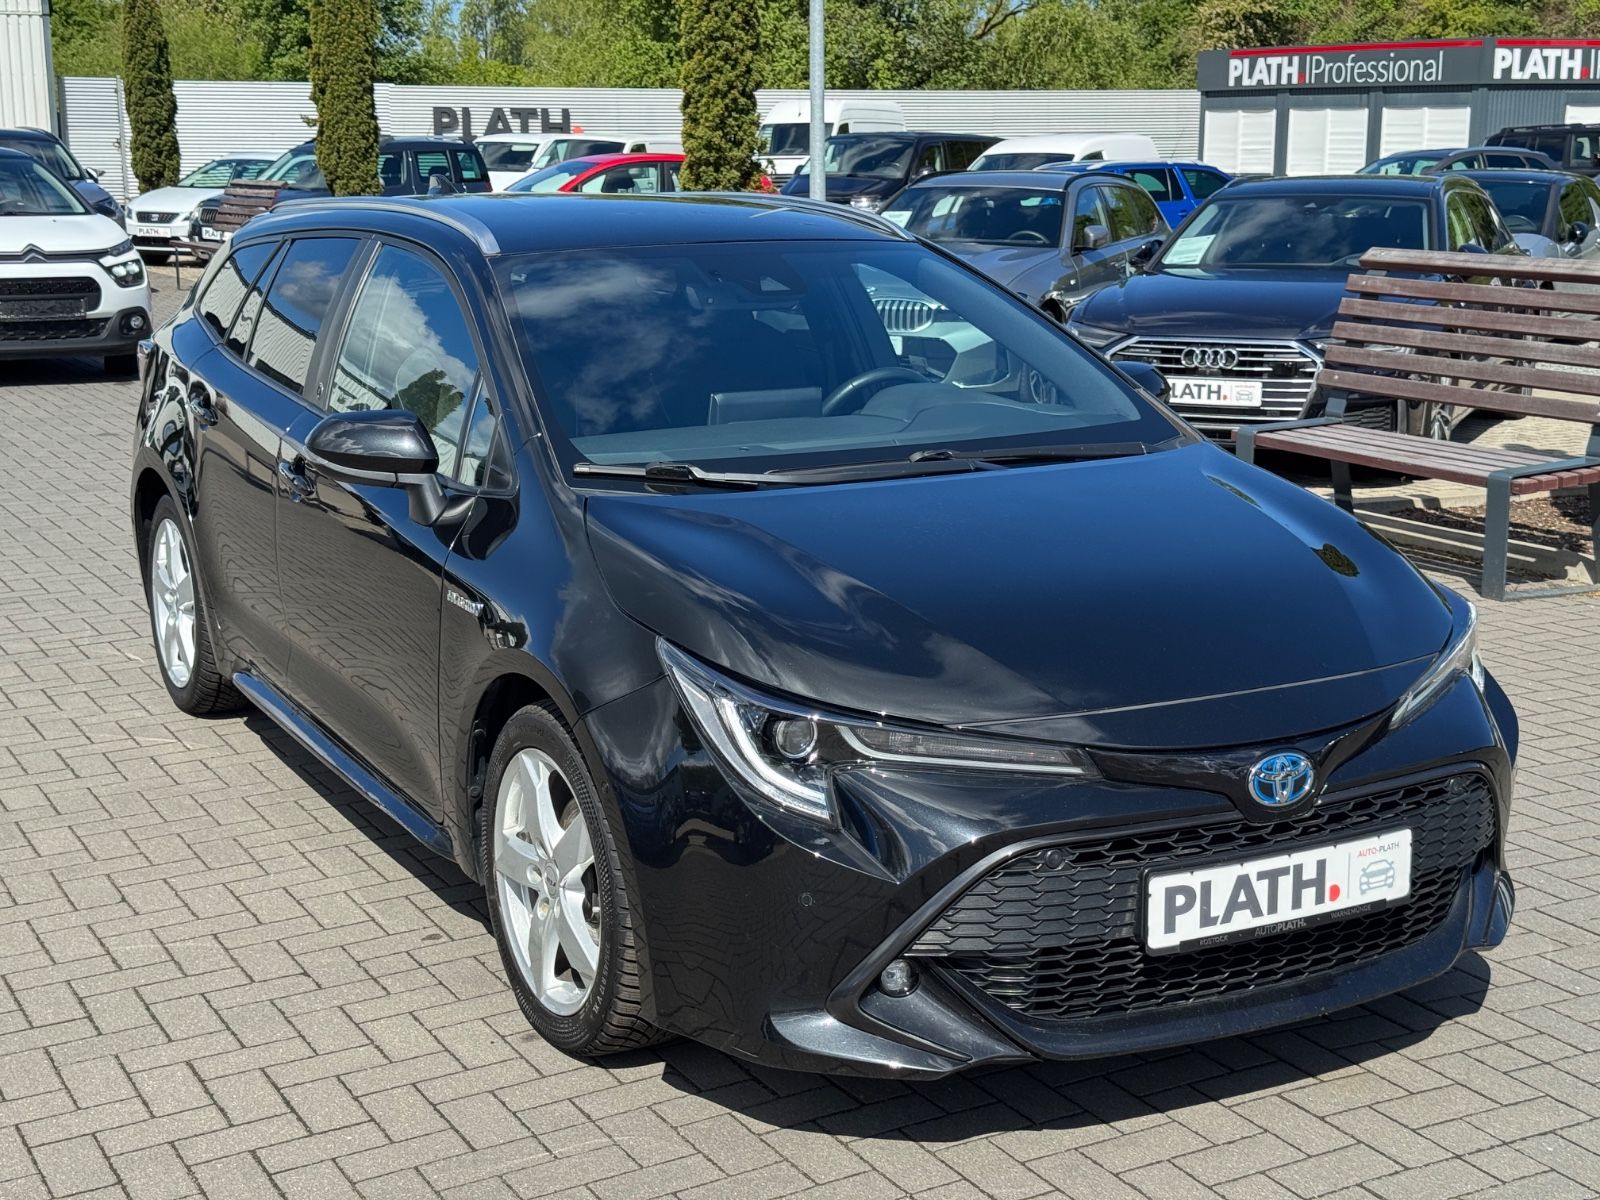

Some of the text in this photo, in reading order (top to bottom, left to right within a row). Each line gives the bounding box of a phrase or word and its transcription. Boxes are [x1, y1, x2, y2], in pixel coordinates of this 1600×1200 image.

[1228, 50, 1444, 87] PLATH. Professional
[1493, 47, 1590, 80] PLATH.
[432, 106, 585, 144] PLATH.
[1171, 382, 1227, 401] LATH.
[1358, 841, 1400, 857] AUTO-PLATH
[1163, 858, 1341, 935] PLATH.
